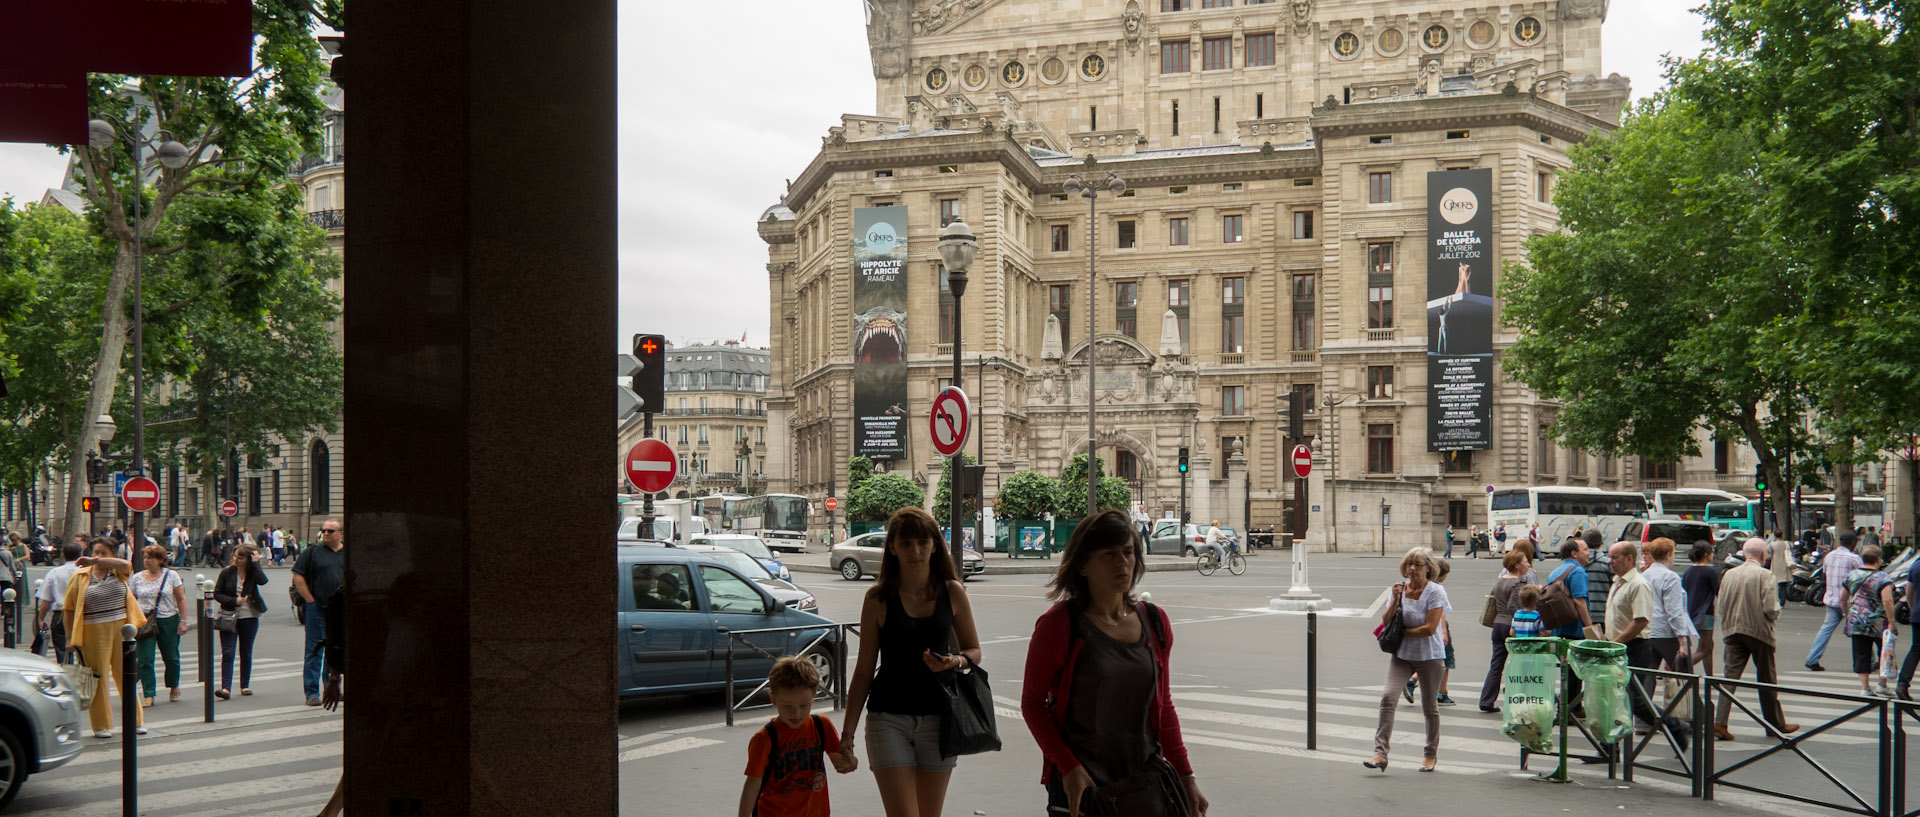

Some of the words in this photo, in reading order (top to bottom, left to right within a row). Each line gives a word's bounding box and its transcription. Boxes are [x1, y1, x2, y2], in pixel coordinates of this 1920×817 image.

[1444, 230, 1474, 238] BALLET
[1449, 236, 1481, 245] L'OPÉRA
[1438, 252, 1465, 260] JUILLET
[861, 260, 902, 268] HIPPOLYTE
